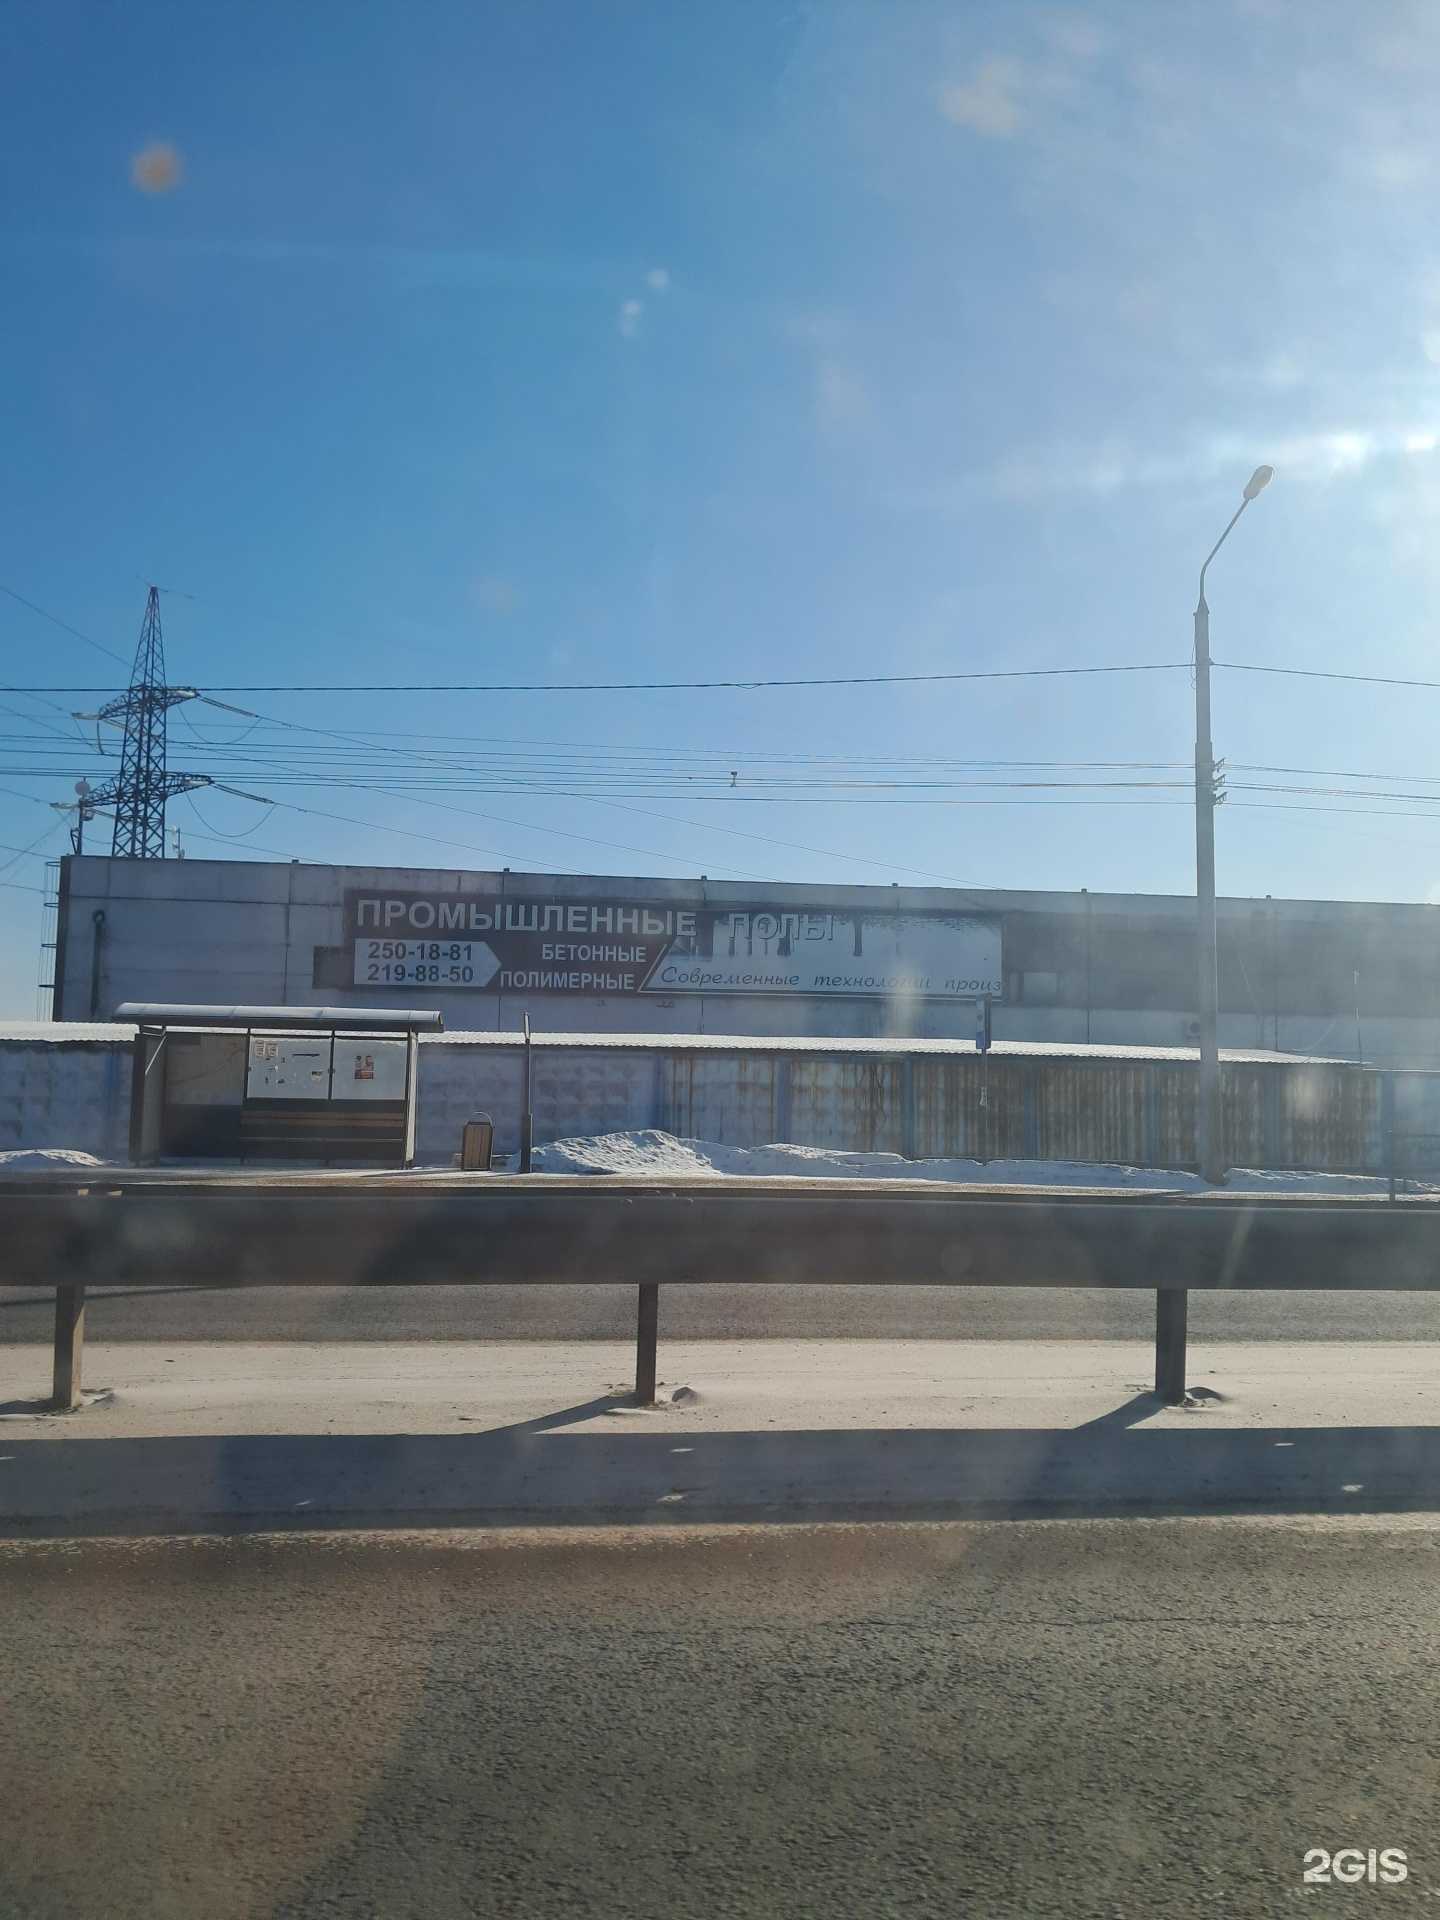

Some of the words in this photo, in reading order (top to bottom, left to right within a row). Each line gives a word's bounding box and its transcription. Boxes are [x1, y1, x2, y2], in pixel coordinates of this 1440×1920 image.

[355, 899, 698, 937] ПРОМЫШЛЕННЫЕ
[728, 912, 836, 942] ПОЛЫ
[367, 941, 474, 961] 250-18-81
[541, 943, 647, 964] БЕТОННЫЕ
[367, 964, 474, 983] 219-88-50
[501, 970, 635, 991] ПОЛИМЕРНЫЕ
[661, 966, 800, 987] Современные
